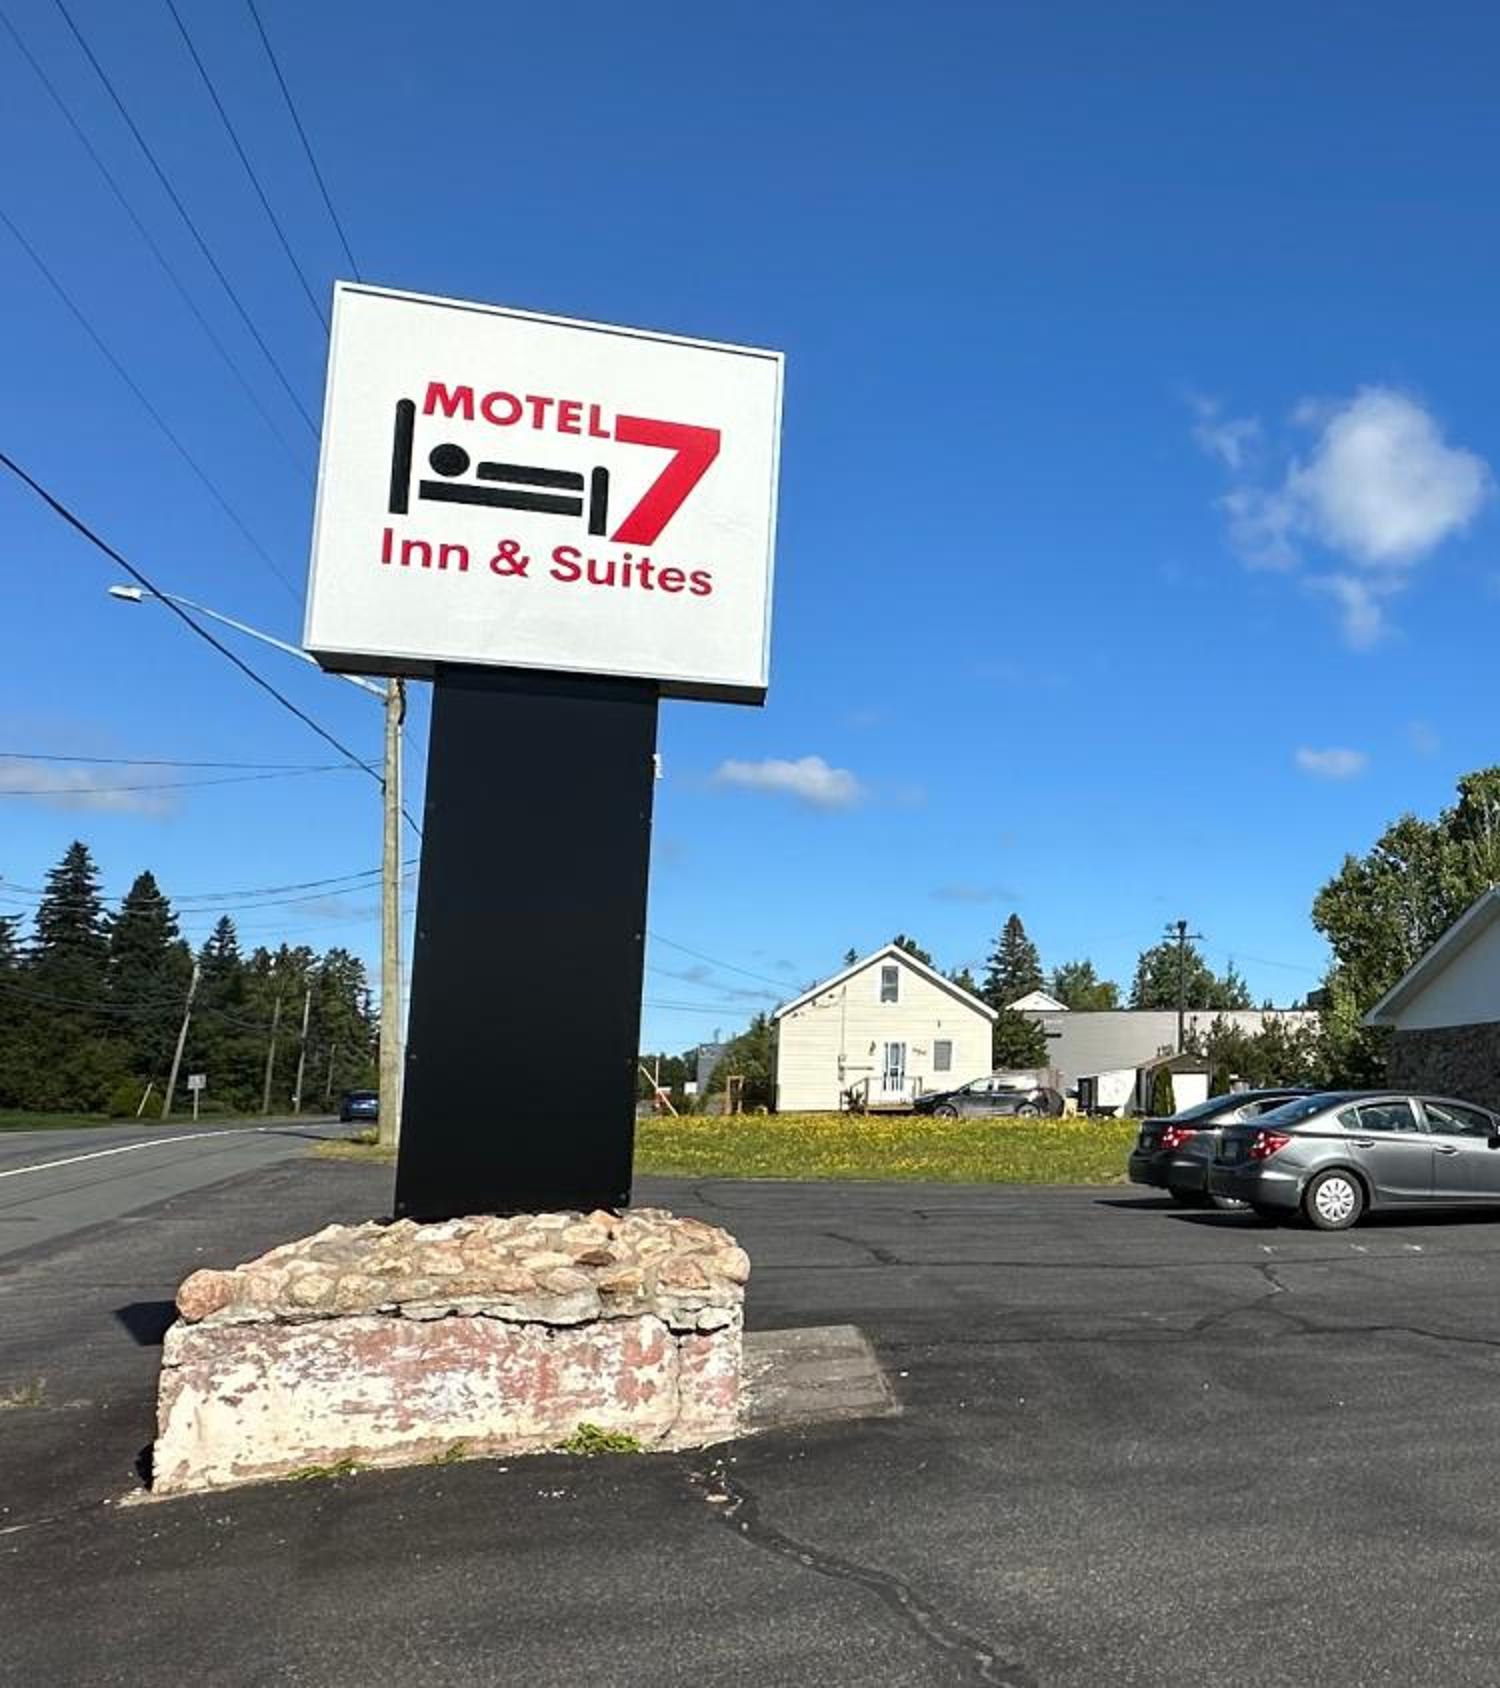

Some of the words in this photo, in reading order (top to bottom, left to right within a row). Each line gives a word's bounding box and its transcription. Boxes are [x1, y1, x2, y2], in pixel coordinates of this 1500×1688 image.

[422, 381, 610, 440] MOTEL
[611, 414, 722, 547] 7
[381, 527, 470, 571] Inn
[489, 539, 530, 577] &
[550, 545, 714, 597] Suites
